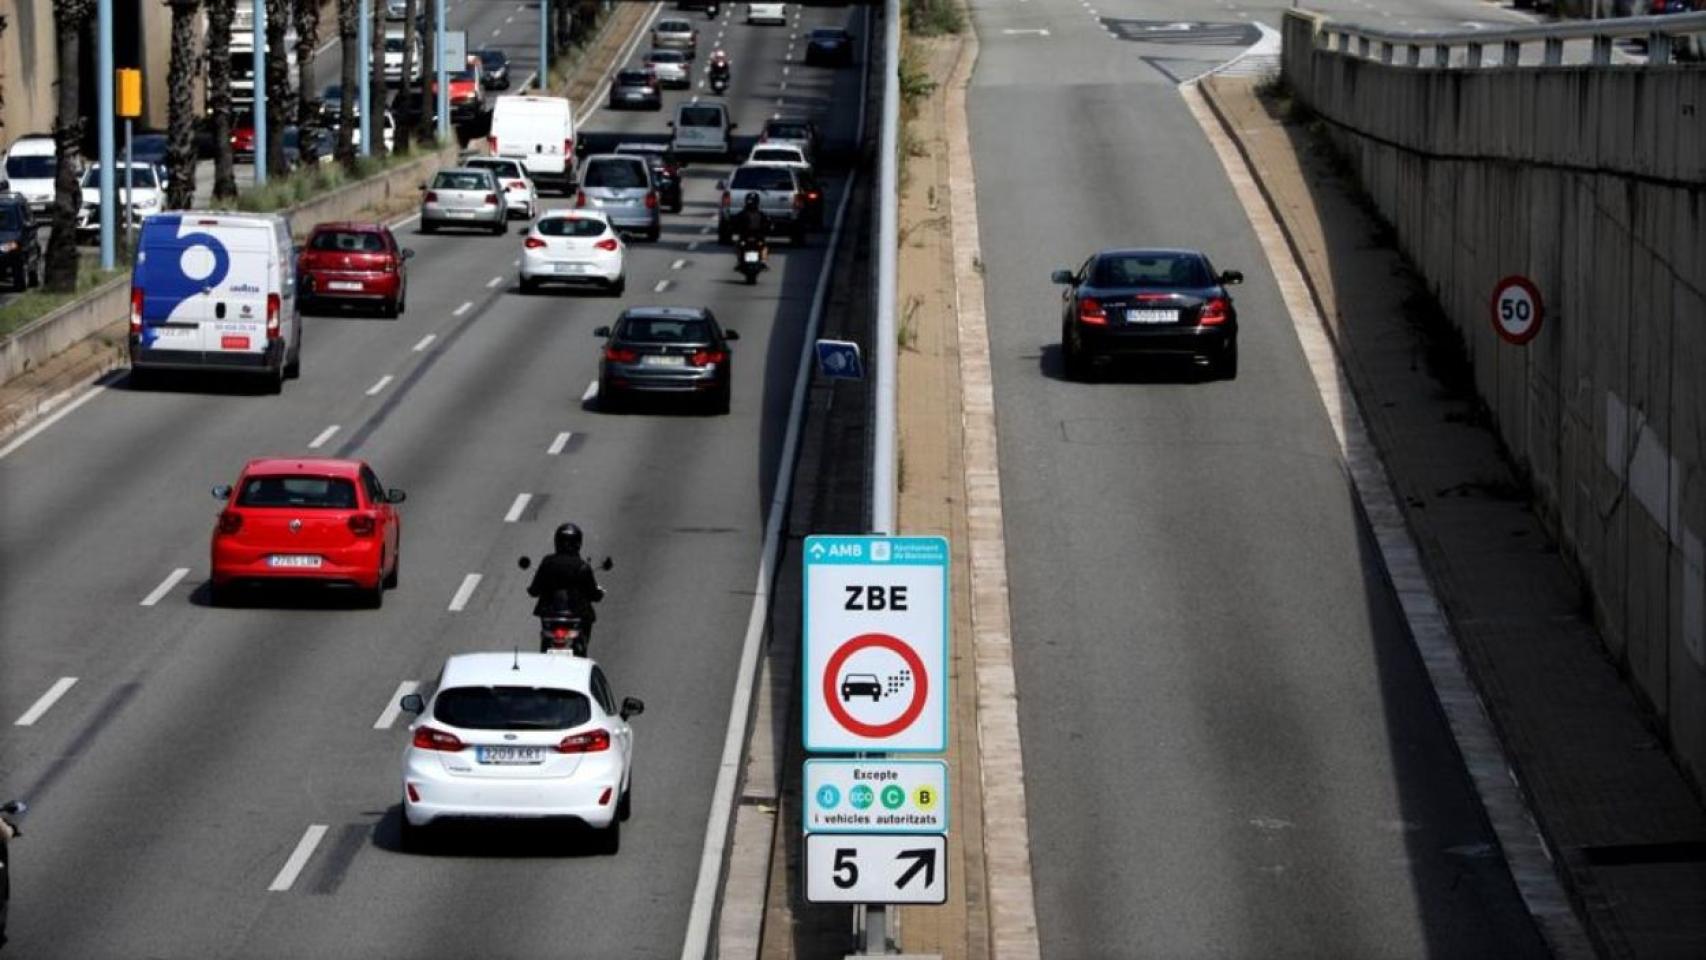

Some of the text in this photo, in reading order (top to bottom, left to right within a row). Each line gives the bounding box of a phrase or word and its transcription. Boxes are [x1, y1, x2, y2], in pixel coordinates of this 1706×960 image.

[1502, 298, 1531, 321] 50
[828, 544, 862, 557] AMB
[845, 586, 908, 611] ZBE
[853, 768, 898, 781] Excepte
[886, 788, 899, 805] C
[919, 789, 930, 804] B
[825, 814, 870, 824] vehicles
[876, 814, 937, 824] autoritzats
[832, 848, 858, 889] 5
